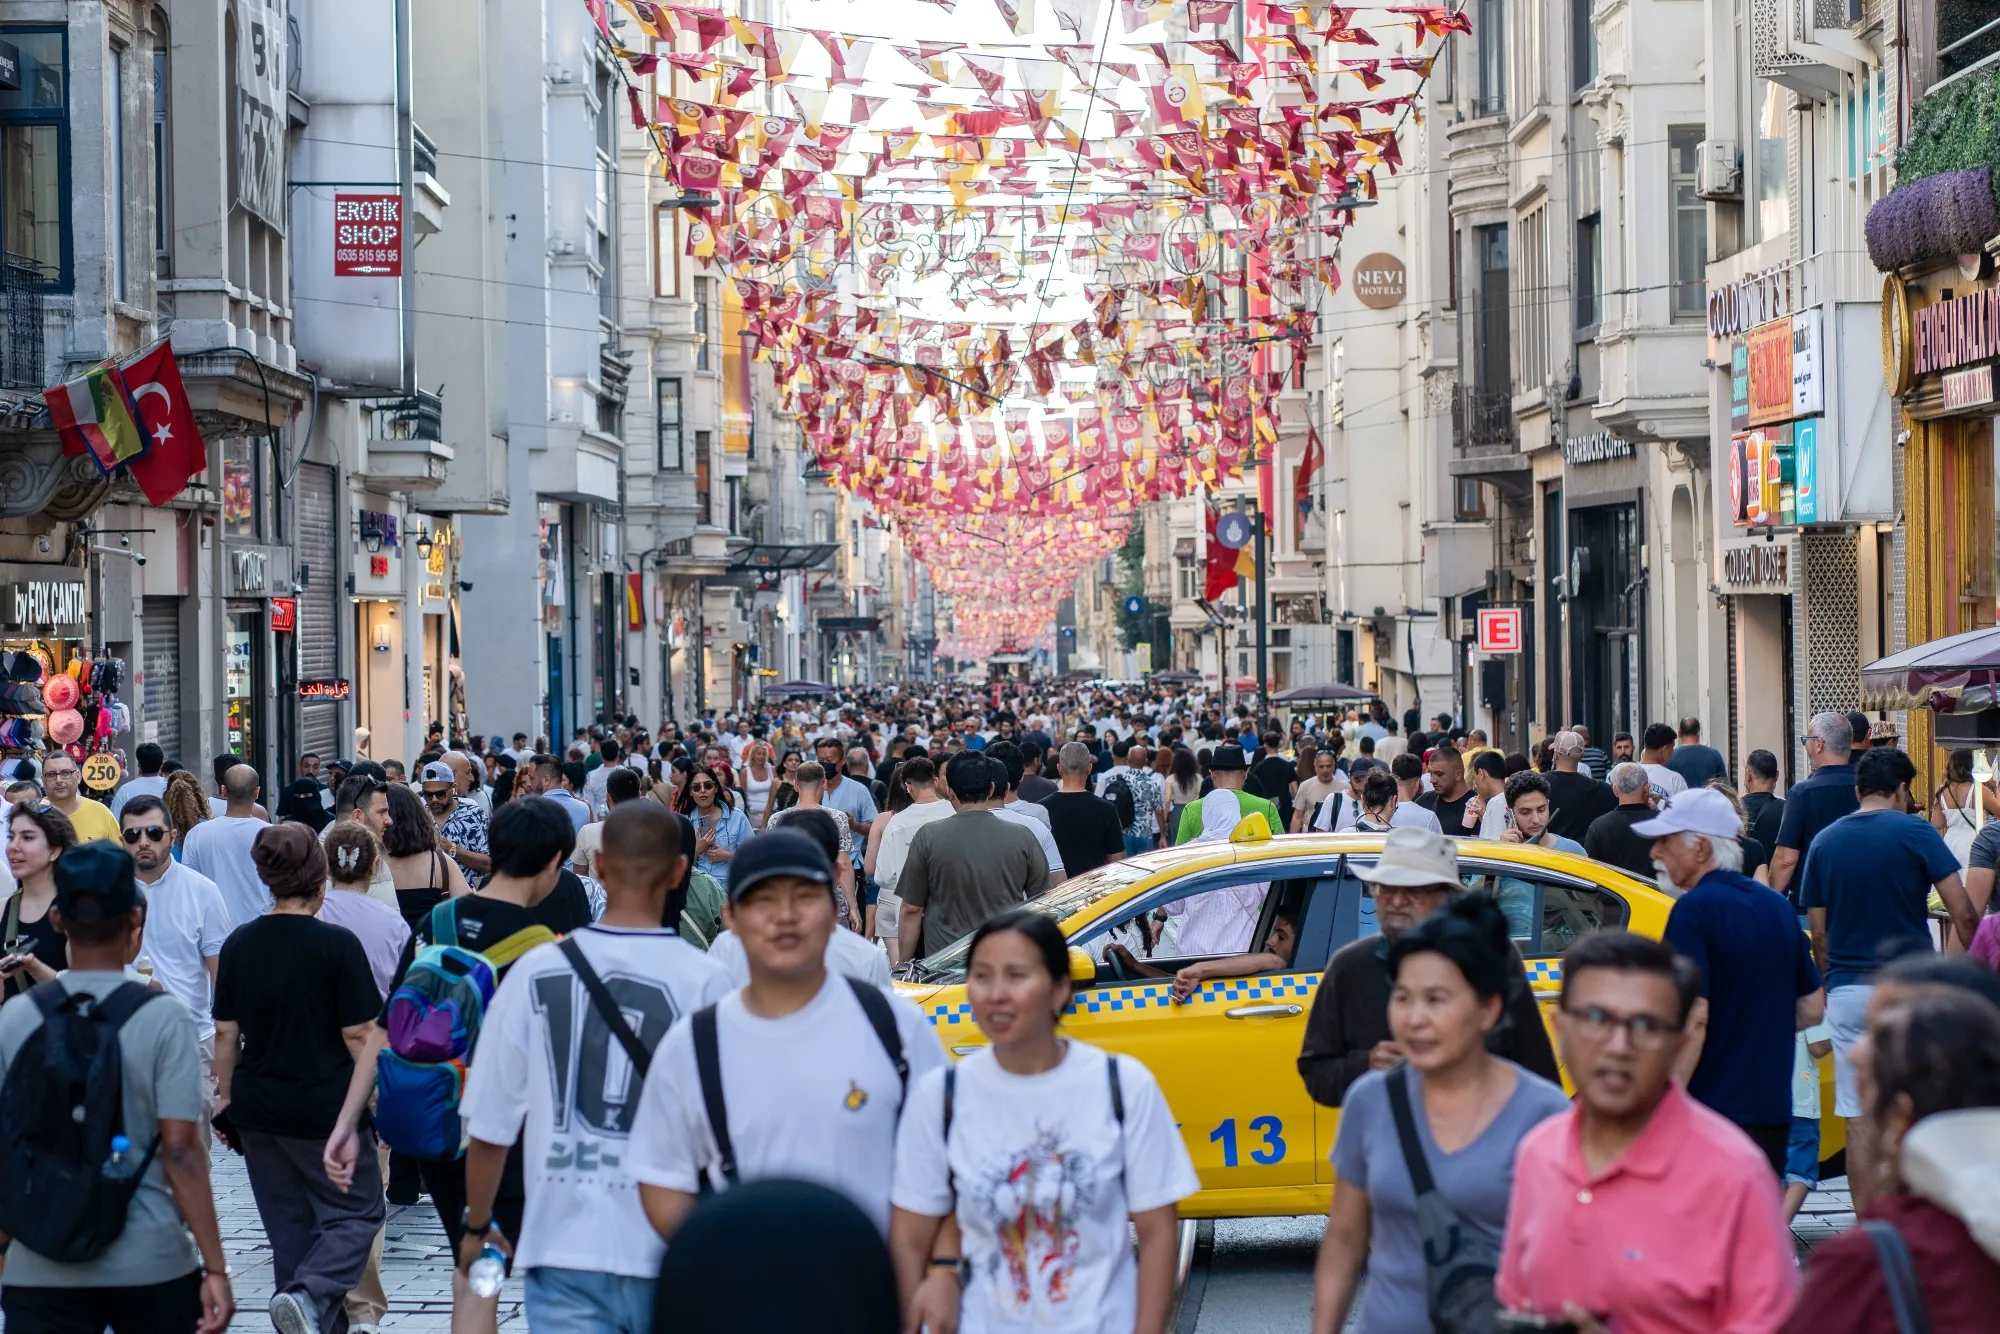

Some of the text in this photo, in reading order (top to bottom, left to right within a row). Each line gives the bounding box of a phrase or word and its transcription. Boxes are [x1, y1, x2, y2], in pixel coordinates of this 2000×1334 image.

[337, 198, 399, 221] EROTİK
[339, 225, 397, 245] SHOP
[337, 248, 398, 262] 0535 515 95 95
[1357, 270, 1403, 284] NEVI
[1360, 286, 1402, 296] HOTELS
[1943, 370, 1992, 407] RESTAURANT
[1566, 431, 1631, 465] STARBUCKS COFFEE
[1724, 545, 1783, 582] GOLDEN ROSE
[15, 581, 86, 635] by FOX ÇANTA
[1489, 617, 1510, 643] E
[227, 641, 250, 656] ost
[94, 756, 108, 764] 280
[87, 765, 116, 781] 250
[529, 967, 681, 1140] 10
[1209, 1115, 1287, 1168] 13
